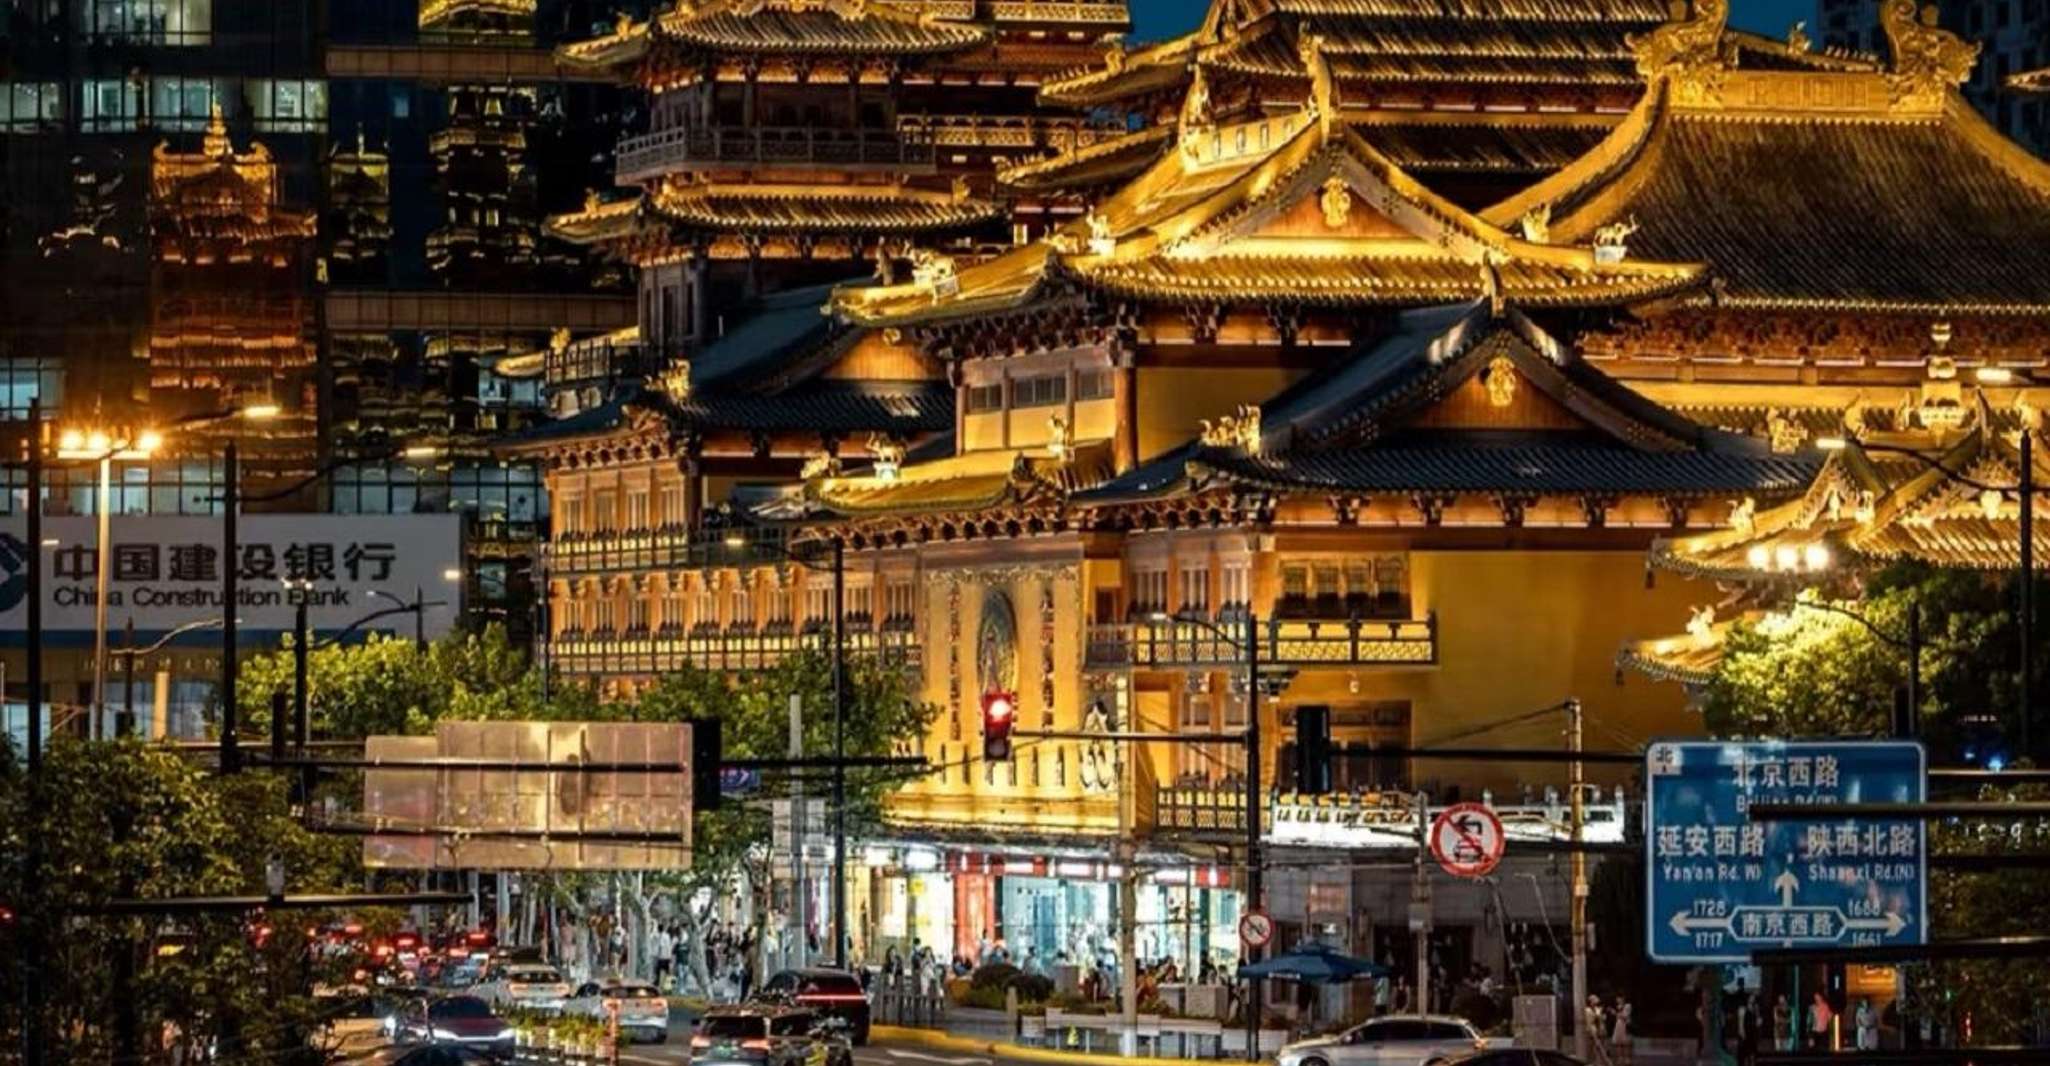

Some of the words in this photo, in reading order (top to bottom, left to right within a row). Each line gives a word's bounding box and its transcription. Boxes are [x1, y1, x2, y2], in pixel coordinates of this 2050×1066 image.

[54, 543, 396, 581] 中国建设银行
[132, 587, 280, 606] Constrution
[1733, 756, 1839, 787] 北京西路
[1657, 824, 1765, 857] 延安西路
[1807, 824, 1916, 857] 陕西北路
[1693, 900, 1726, 916] 1728
[1742, 911, 1834, 936] 南京西路
